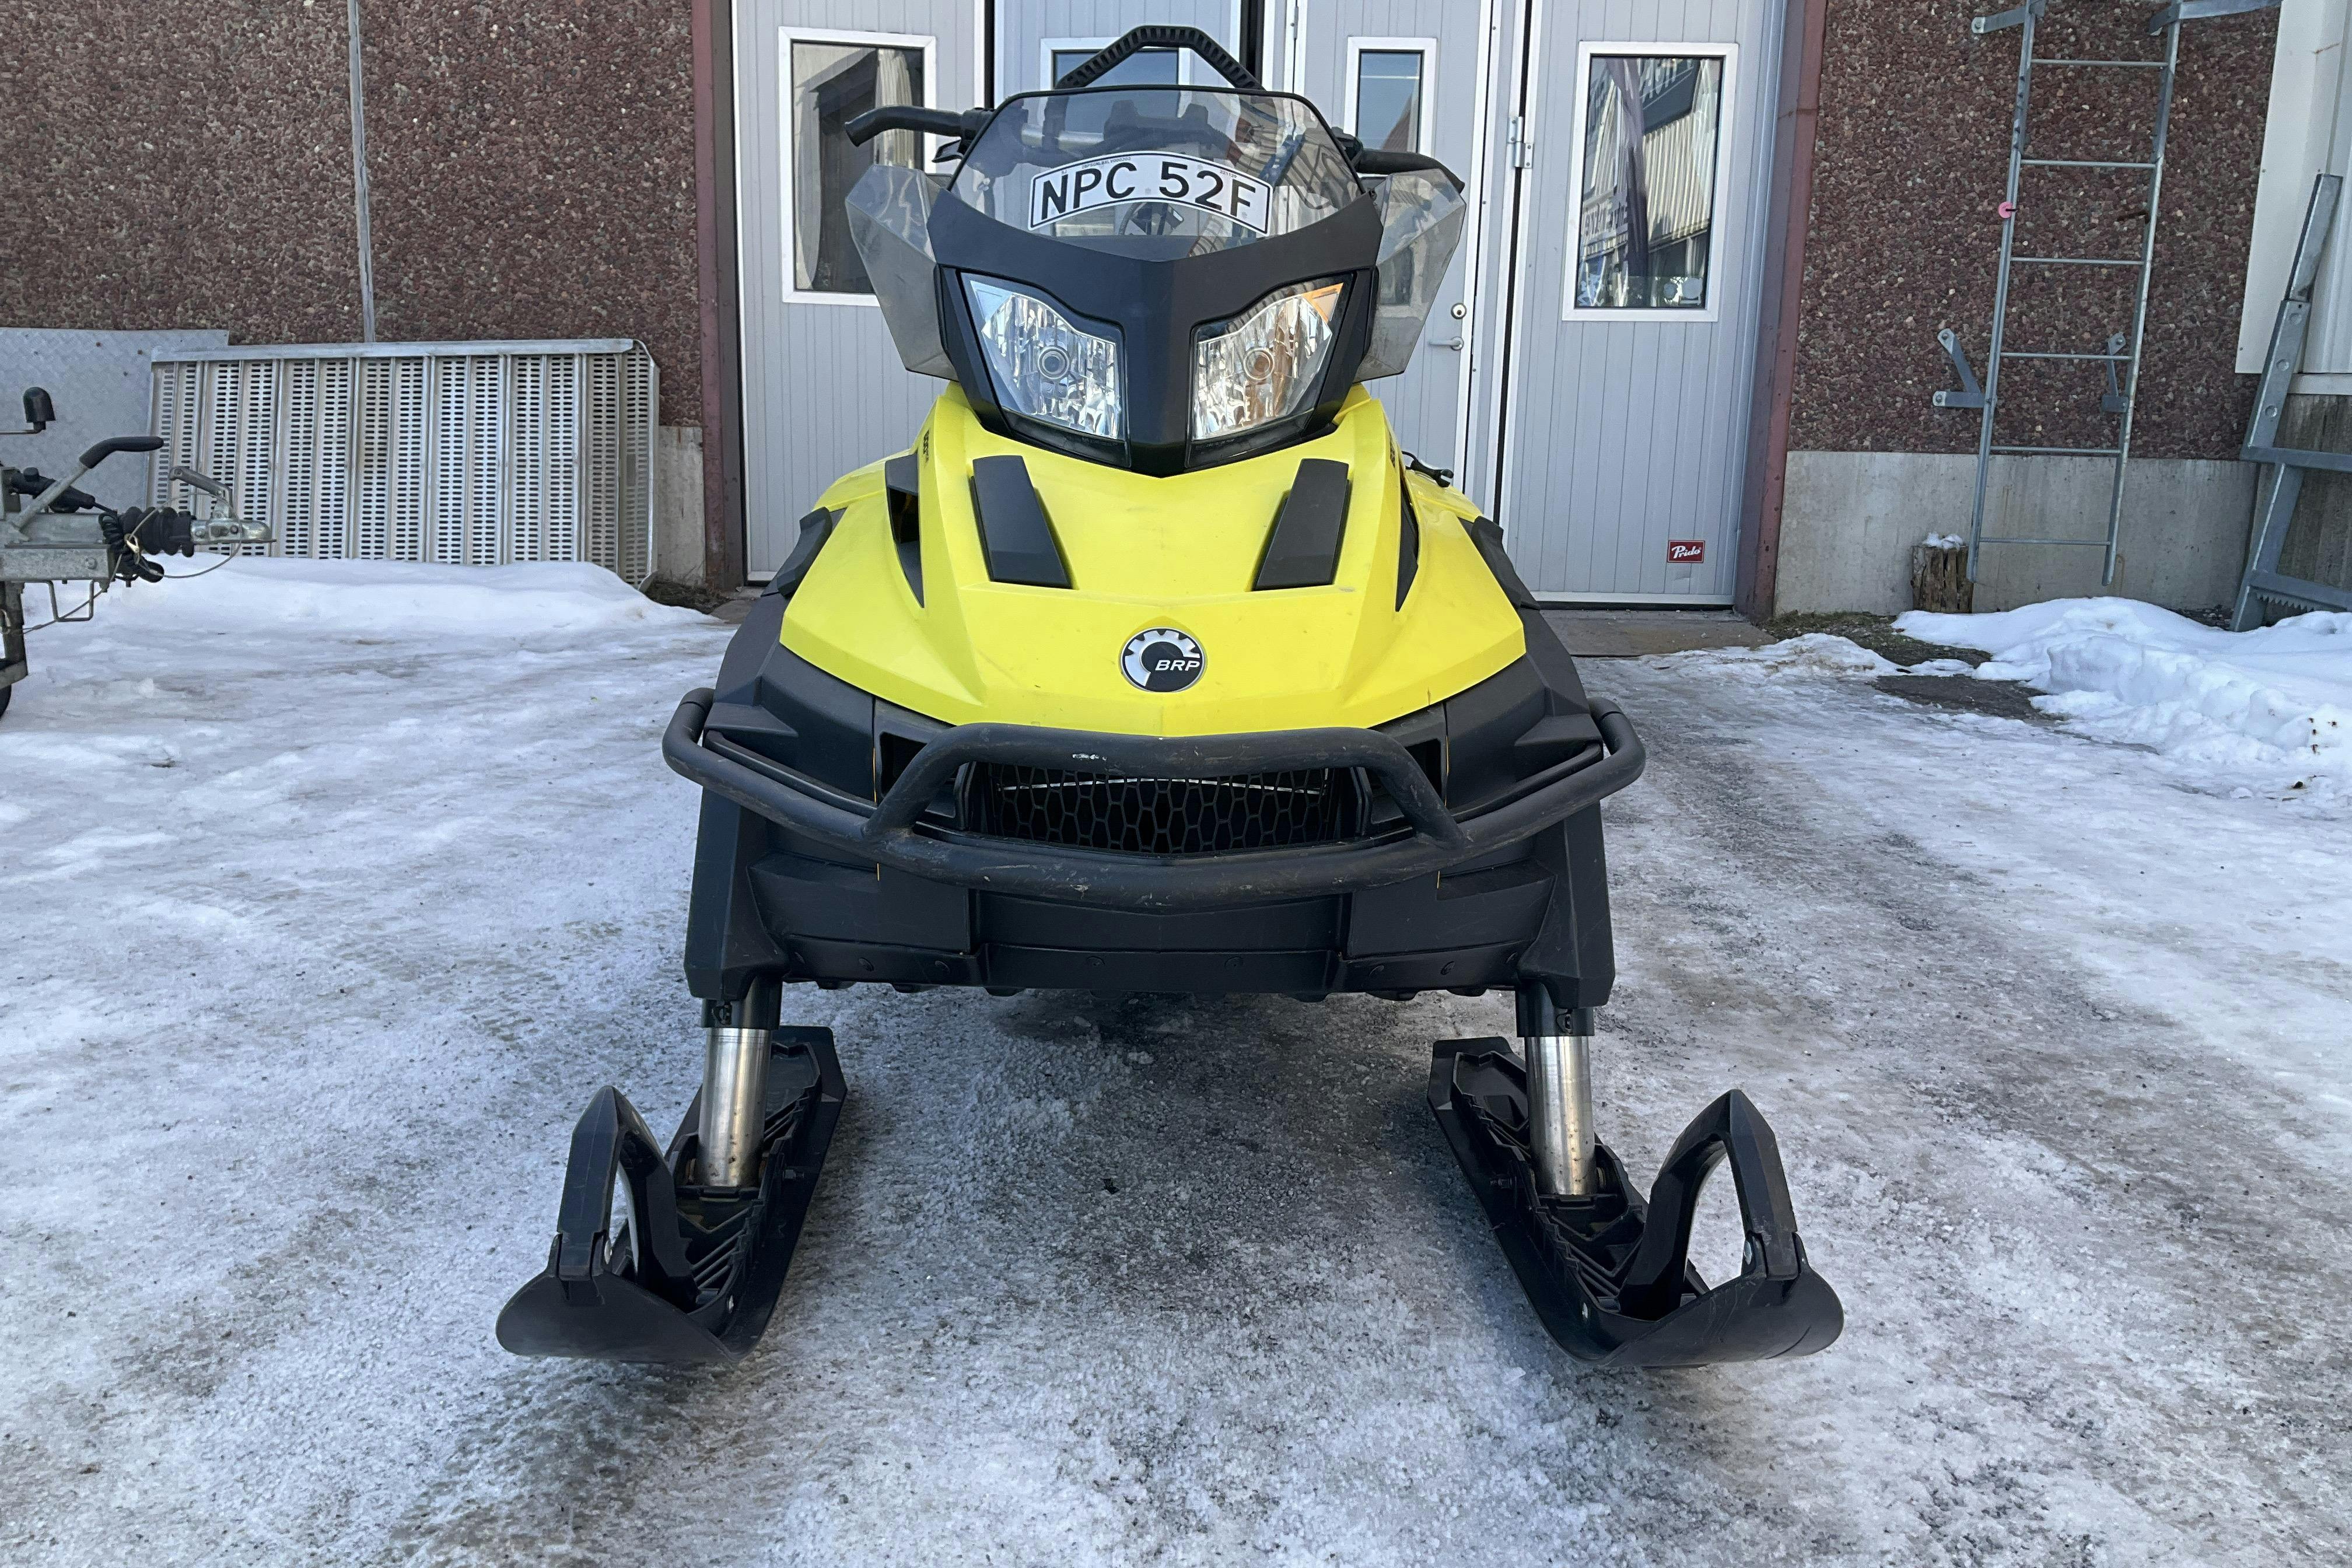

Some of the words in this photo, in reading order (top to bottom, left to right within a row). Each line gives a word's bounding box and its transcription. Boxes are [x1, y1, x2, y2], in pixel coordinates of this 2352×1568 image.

[1041, 162, 1137, 220] NPC
[1158, 160, 1256, 218] 52F
[1671, 545, 1701, 559] Prido
[1154, 659, 1200, 671] BRP
